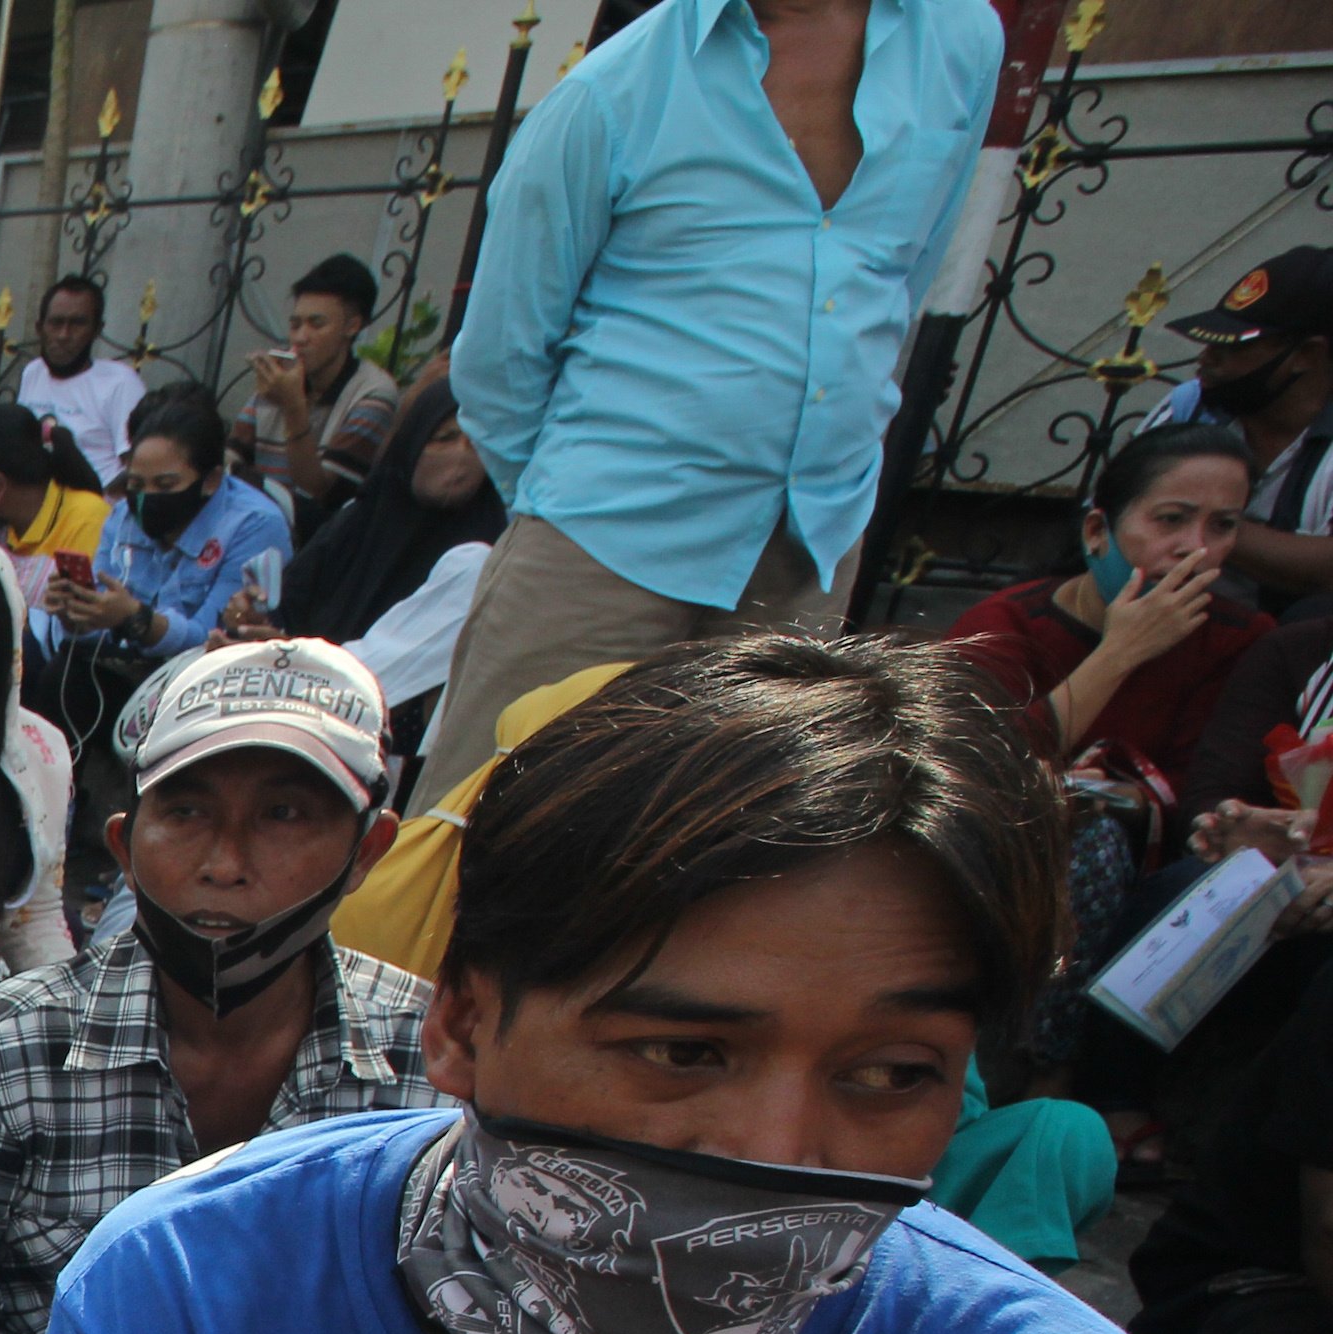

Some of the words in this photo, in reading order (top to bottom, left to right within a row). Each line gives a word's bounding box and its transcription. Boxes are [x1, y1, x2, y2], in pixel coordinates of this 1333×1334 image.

[226, 667, 252, 676] LIVE
[177, 674, 371, 726] GREENLIGHT
[229, 701, 268, 712] EST.
[533, 1154, 625, 1214] PERSEBAYA
[686, 1211, 869, 1253] PERSEBAYA
